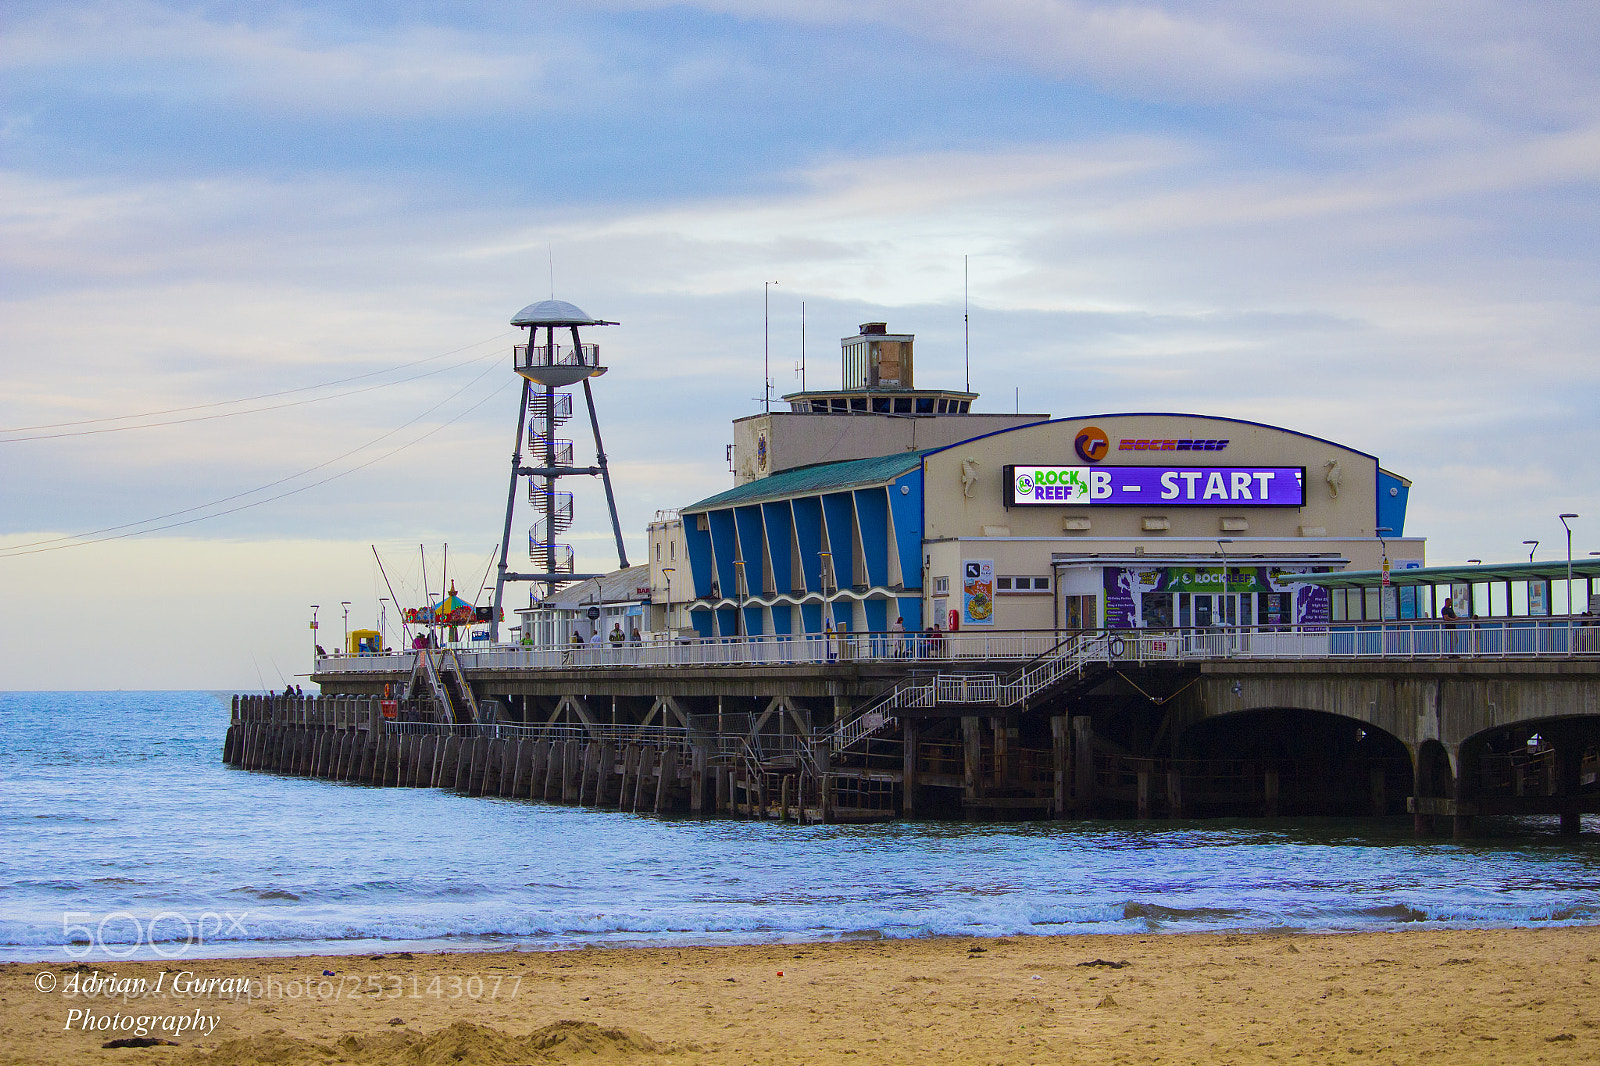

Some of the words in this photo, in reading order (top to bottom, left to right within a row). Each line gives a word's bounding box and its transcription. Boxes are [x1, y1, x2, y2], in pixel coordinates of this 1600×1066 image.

[1119, 439, 1229, 451] ROCKREEF
[1035, 470, 1079, 485] ROCK
[1160, 471, 1275, 500] START
[1035, 486, 1073, 500] REEF
[1195, 573, 1251, 584] ROCKREEF
